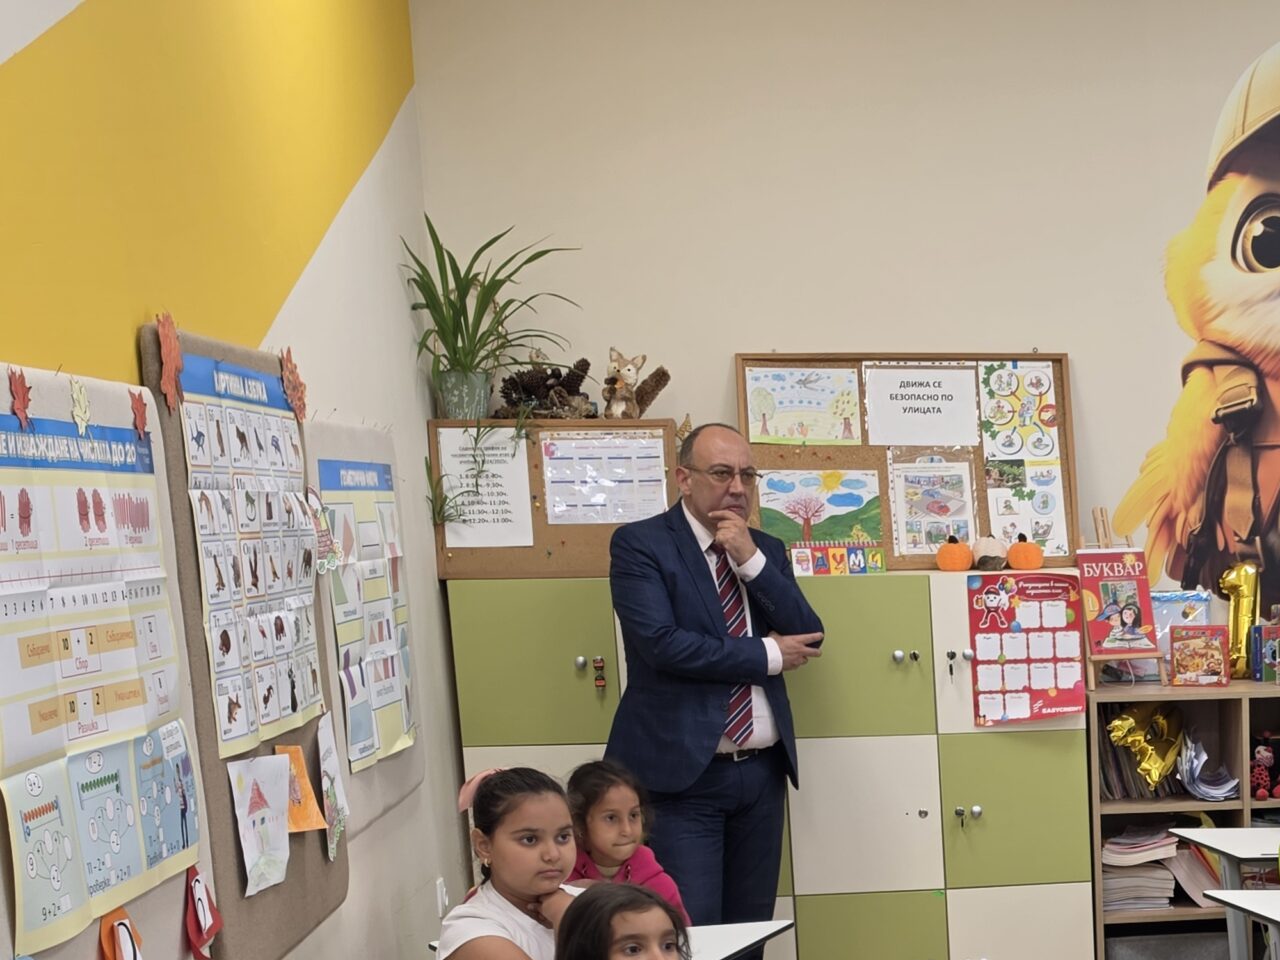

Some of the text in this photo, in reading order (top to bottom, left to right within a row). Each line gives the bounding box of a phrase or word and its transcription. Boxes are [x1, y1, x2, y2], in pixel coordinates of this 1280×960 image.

[900, 380, 942, 389] ДВИЖА СЕ
[889, 393, 939, 401] БЕЗОПАСНО
[902, 406, 942, 415] УЛИЦАТА
[112, 441, 125, 466] ДО
[125, 446, 136, 464] 20
[1083, 561, 1144, 578] БУКВАР
[62, 638, 70, 651] 10
[89, 632, 94, 645] 2
[75, 657, 89, 671] Сбор
[69, 701, 76, 713] 10
[96, 693, 100, 705] 2
